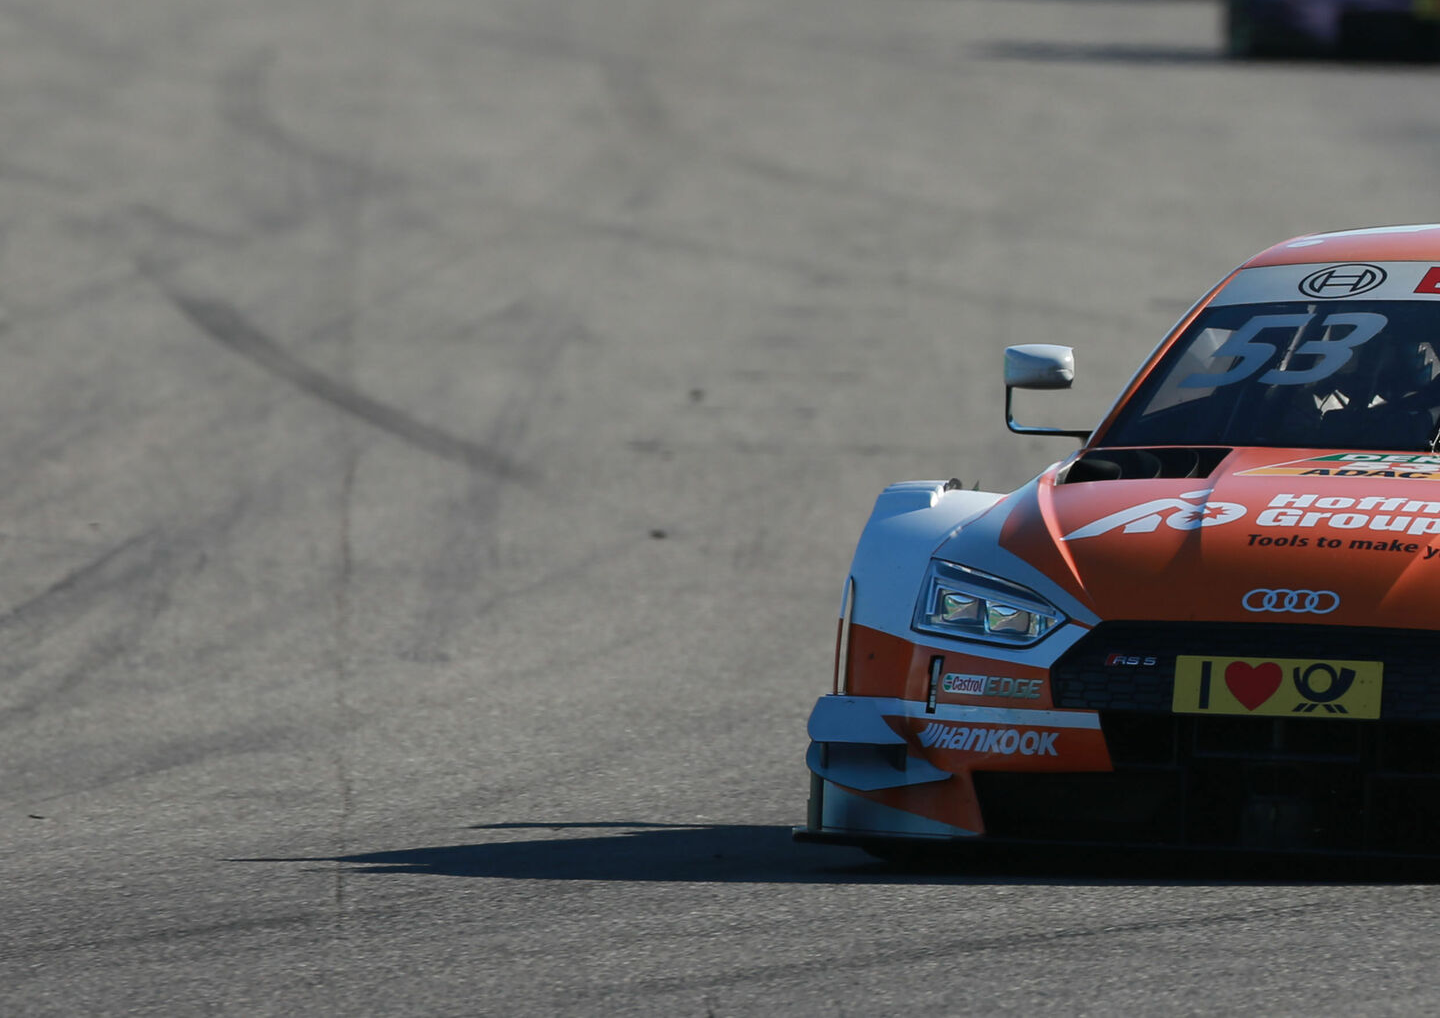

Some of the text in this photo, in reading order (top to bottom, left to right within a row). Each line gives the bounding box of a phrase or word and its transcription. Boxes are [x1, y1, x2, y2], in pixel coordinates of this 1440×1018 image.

[1177, 312, 1389, 388] 53
[1301, 468, 1432, 480] ADAC
[1247, 533, 1310, 548] Tools
[1316, 535, 1343, 549] to
[1348, 537, 1420, 554] make
[1113, 655, 1158, 666] RS 5
[951, 675, 1044, 700] Castrol EDGE
